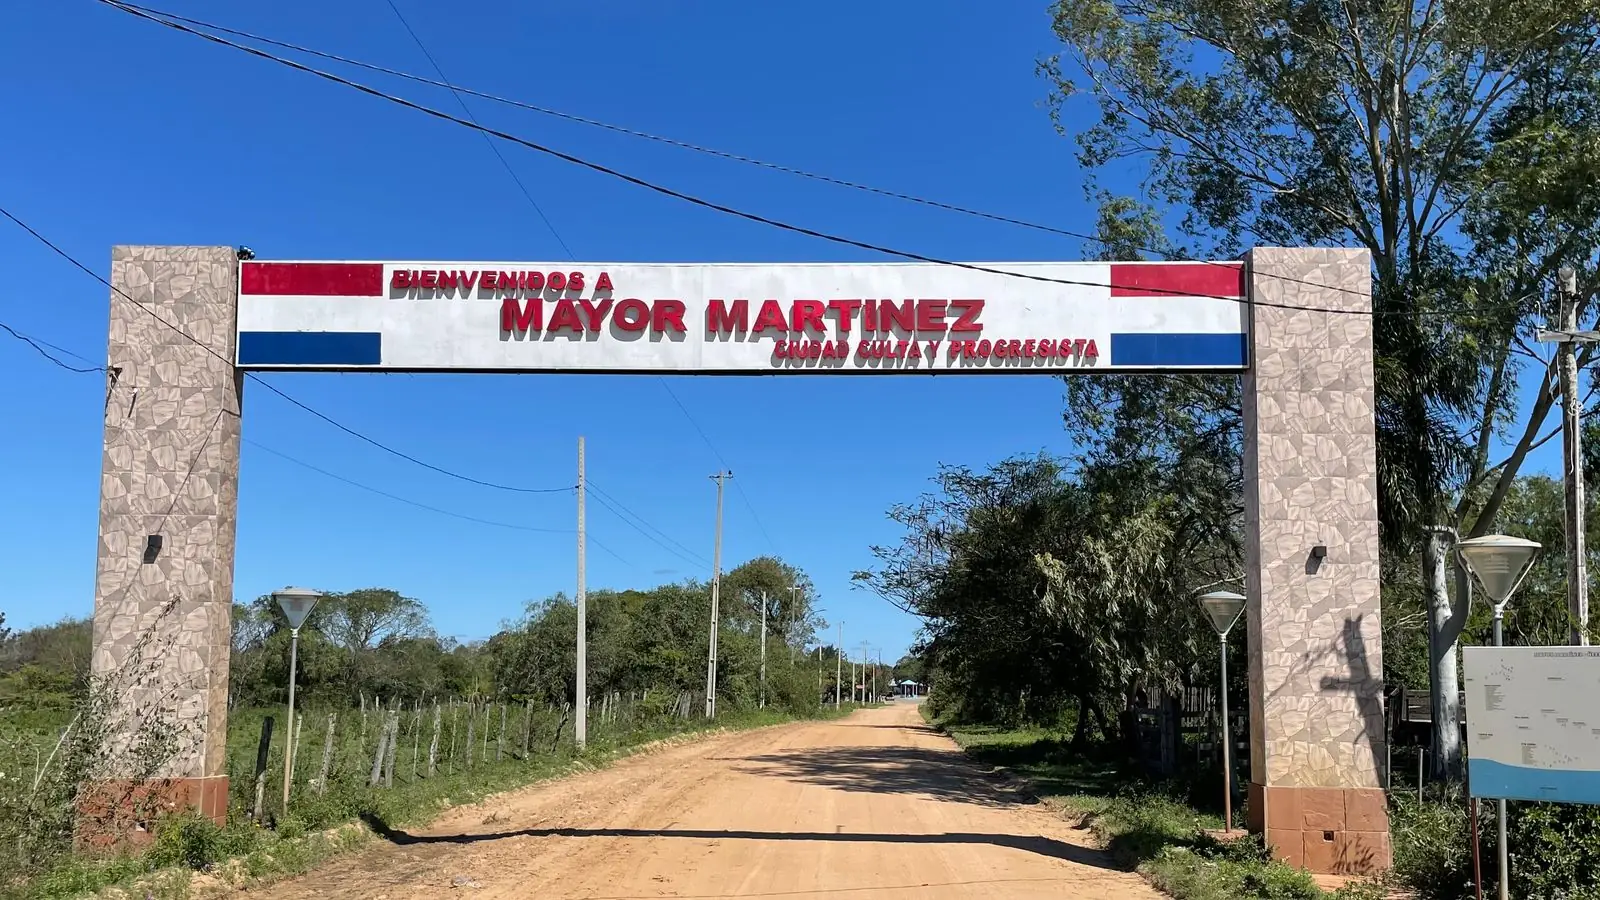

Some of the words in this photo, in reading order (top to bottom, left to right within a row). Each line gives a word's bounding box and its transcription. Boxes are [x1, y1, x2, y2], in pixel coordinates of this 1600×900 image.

[392, 270, 585, 291] BIENVENIDOS
[595, 271, 615, 291] A
[502, 299, 687, 332] MAYOR
[708, 299, 985, 332] MARTINEZ
[774, 339, 850, 359] CIUDAD
[858, 340, 922, 359] CULTA
[926, 340, 939, 359] Y
[948, 339, 1100, 359] PROGRESISTA
